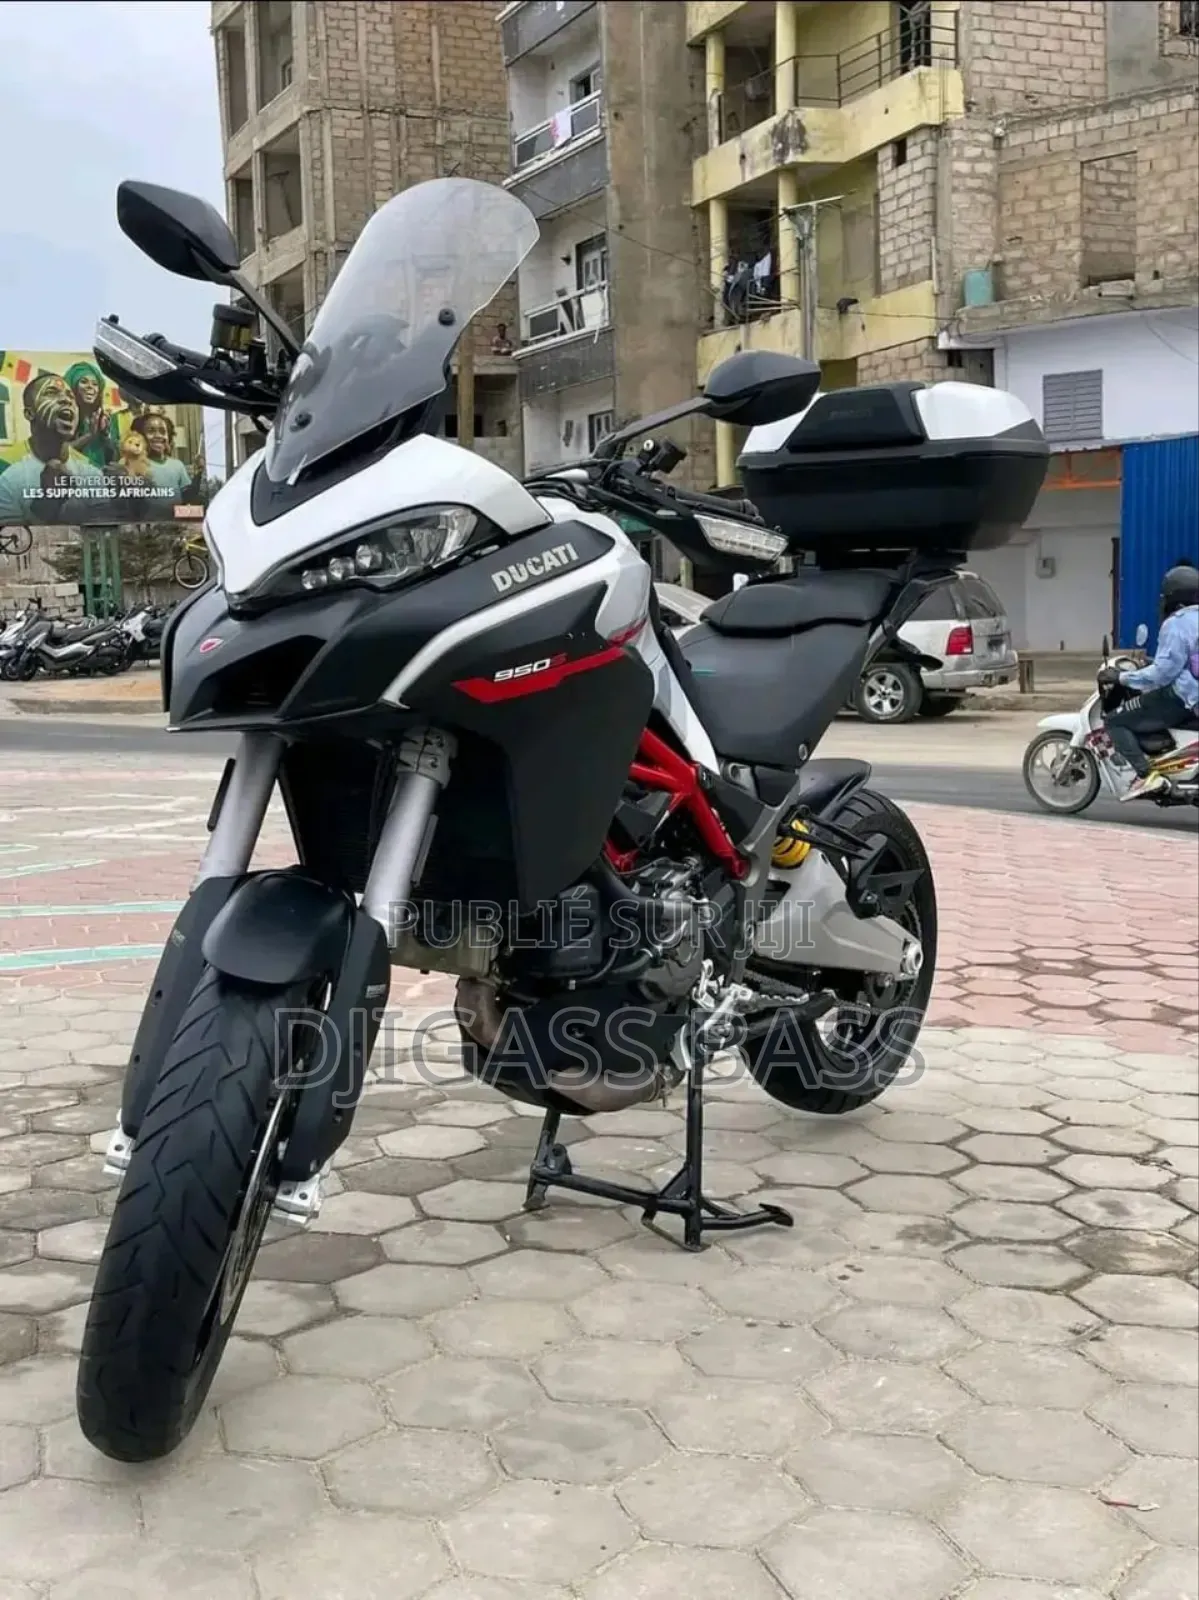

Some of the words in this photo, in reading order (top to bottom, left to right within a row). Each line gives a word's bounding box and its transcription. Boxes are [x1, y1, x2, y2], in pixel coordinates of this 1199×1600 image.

[54, 476, 67, 486] LE
[69, 476, 100, 487] FOYER
[102, 476, 117, 487] DE
[119, 476, 145, 487] TOUS
[23, 487, 45, 498] LES
[46, 487, 118, 498] SUPPORTERS
[119, 487, 175, 498] AFRICAINS
[491, 542, 580, 592] DUCATI
